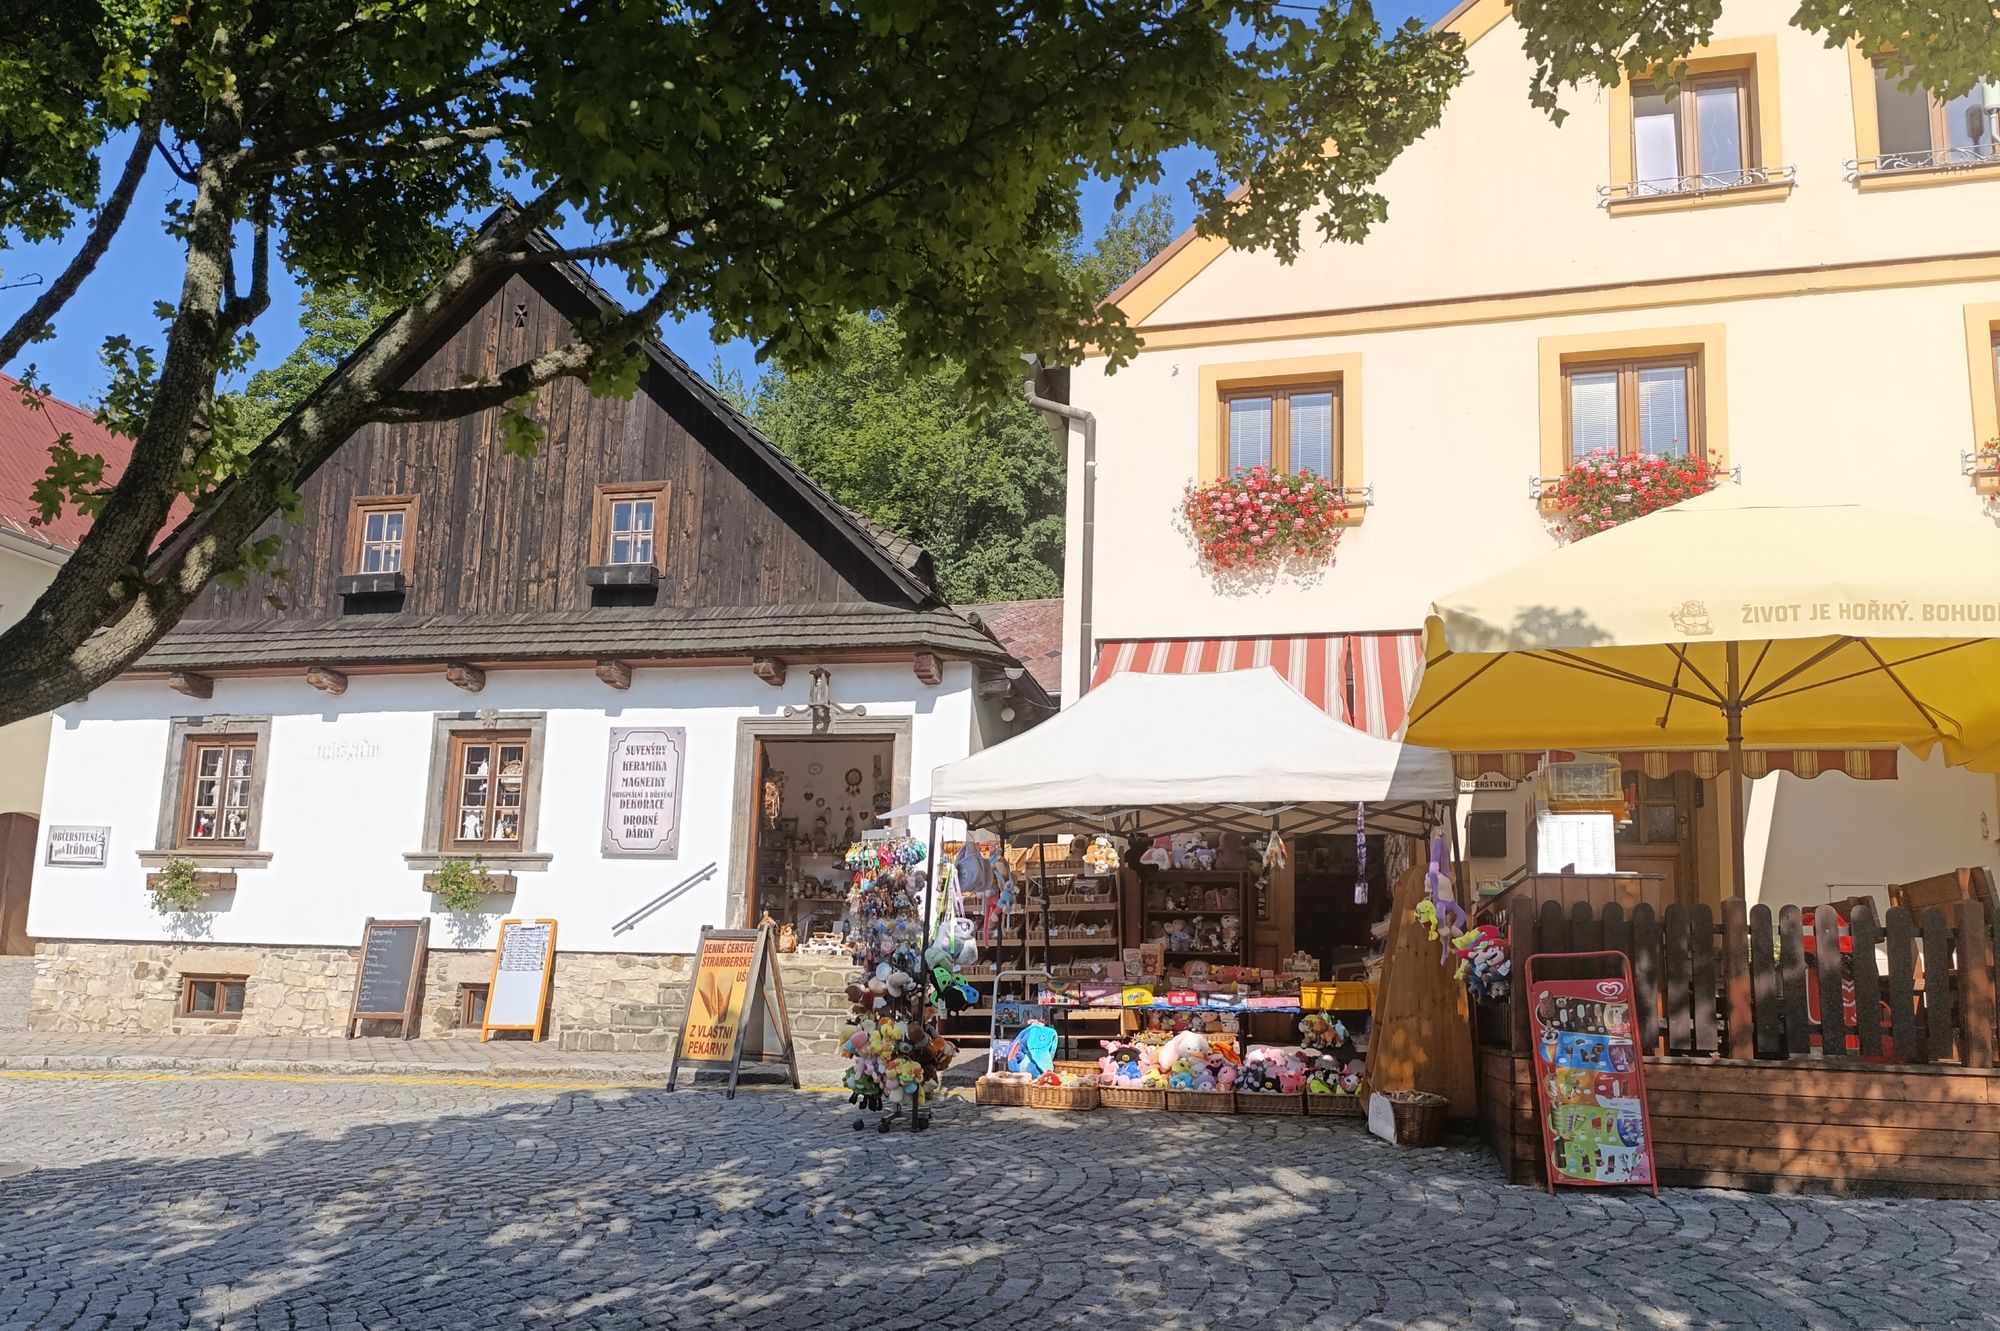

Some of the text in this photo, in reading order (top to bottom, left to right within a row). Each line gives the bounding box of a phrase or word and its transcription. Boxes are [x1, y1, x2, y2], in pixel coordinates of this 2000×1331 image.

[1741, 603, 1802, 624] ŽIVOT
[1809, 603, 1831, 621] JE
[1838, 599, 1914, 621] HOŘKÝ.
[625, 742, 667, 755] SUVENÝRY
[622, 760, 667, 772] KERAMIKA
[621, 776, 666, 788] MAGNETKY
[619, 799, 665, 809] DEKORACE
[623, 812, 659, 825] DROBNÉ
[52, 829, 98, 842] OBČERSTVENÍ
[625, 825, 655, 839] DÁRKY
[689, 1024, 734, 1039] Z VLASTNÍ
[687, 1039, 729, 1056] PEKÁRNY
